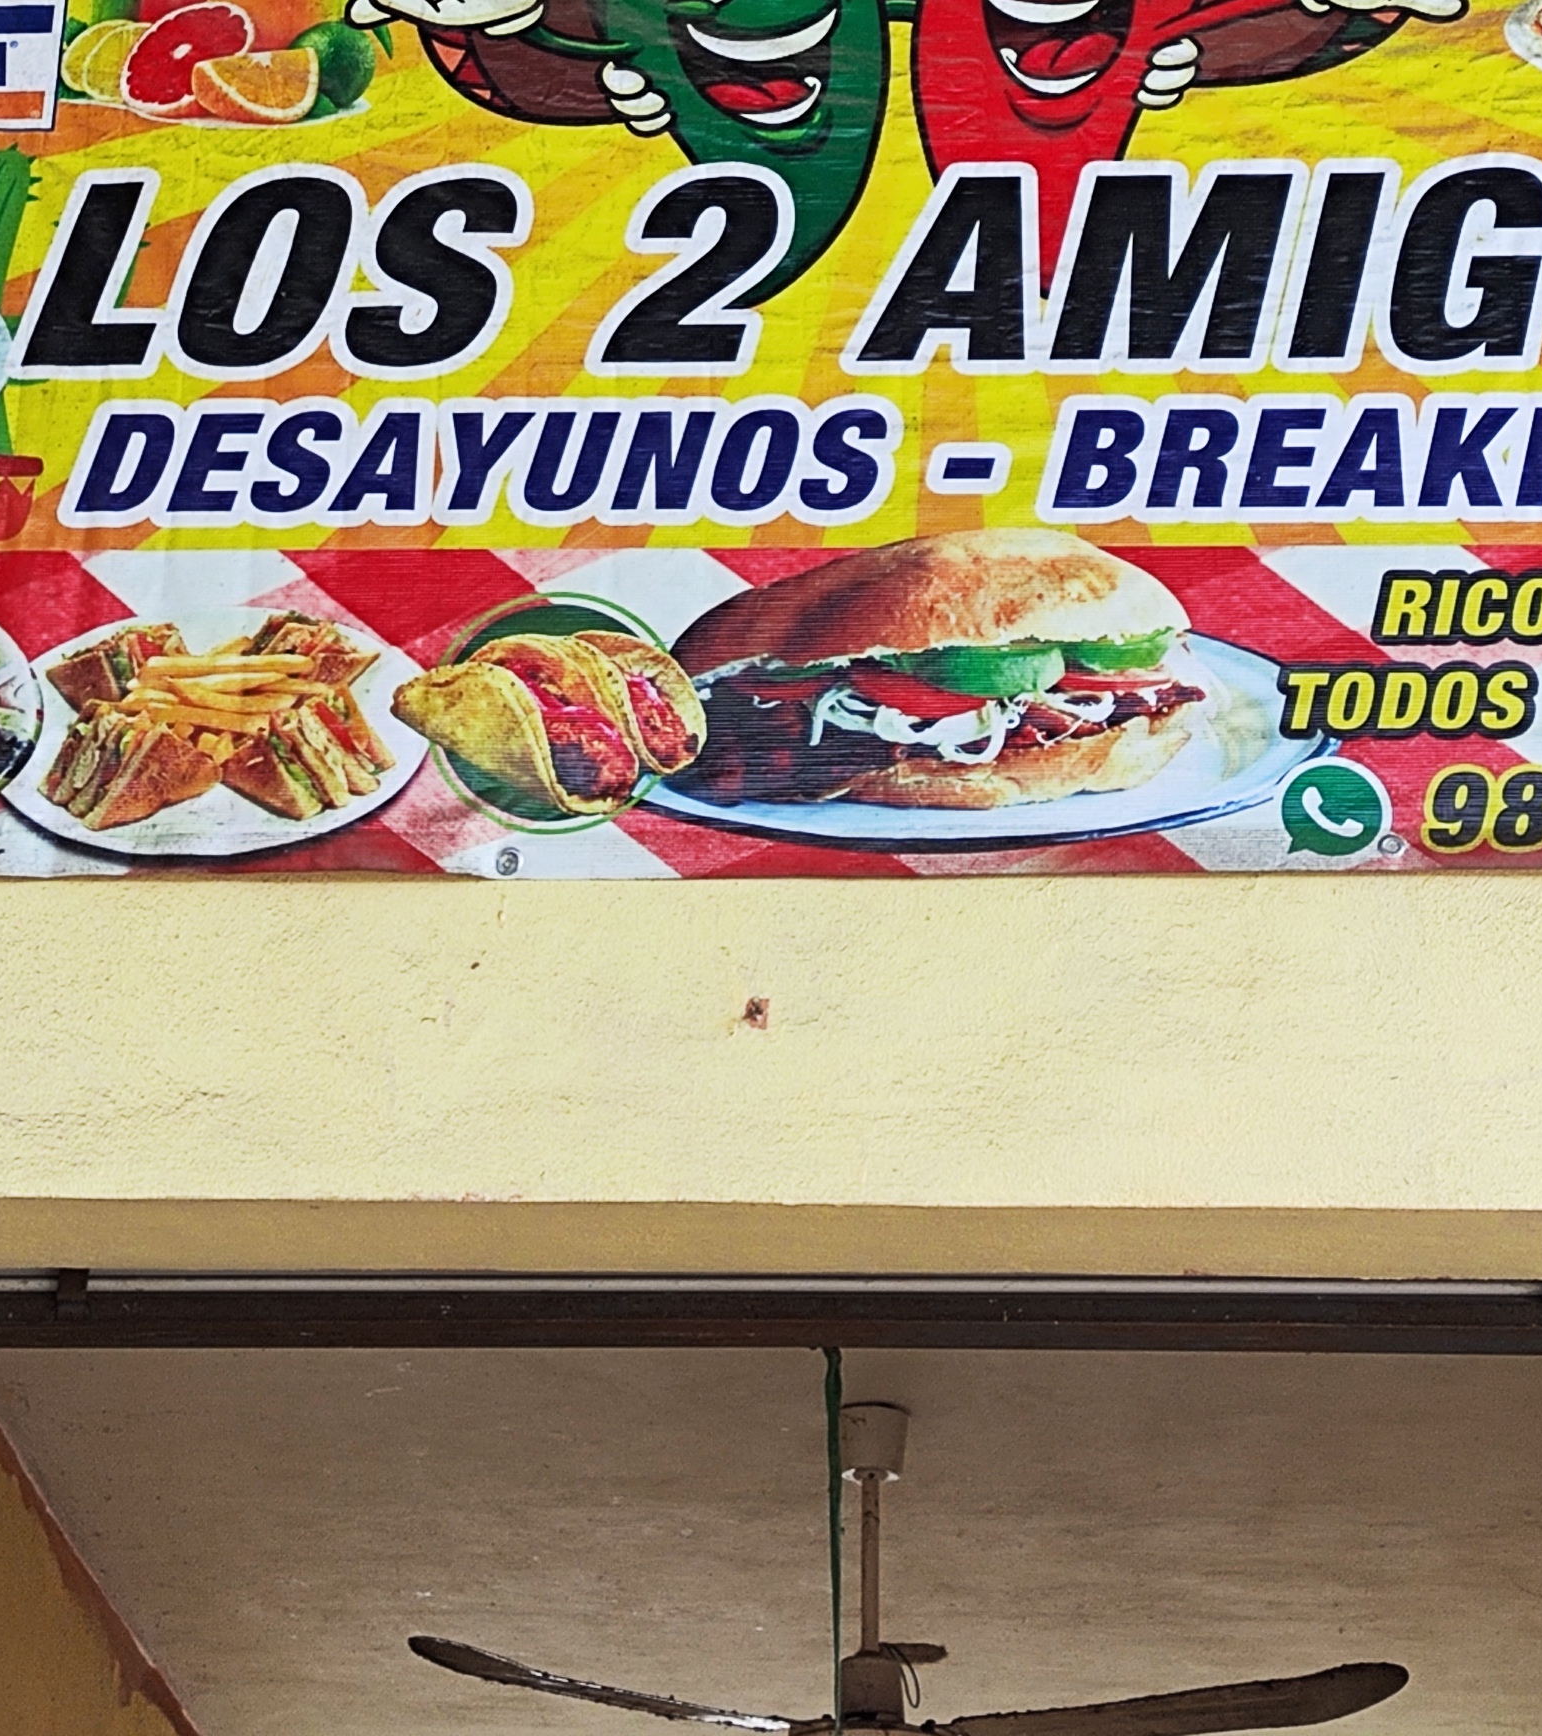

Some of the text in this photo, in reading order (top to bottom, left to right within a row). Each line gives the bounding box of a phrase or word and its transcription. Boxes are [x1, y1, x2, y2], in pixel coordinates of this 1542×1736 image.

[19, 173, 519, 369] LOS
[599, 171, 783, 367] 2
[73, 407, 886, 515] DESAYUNOS
[1283, 668, 1527, 733] TODOS
